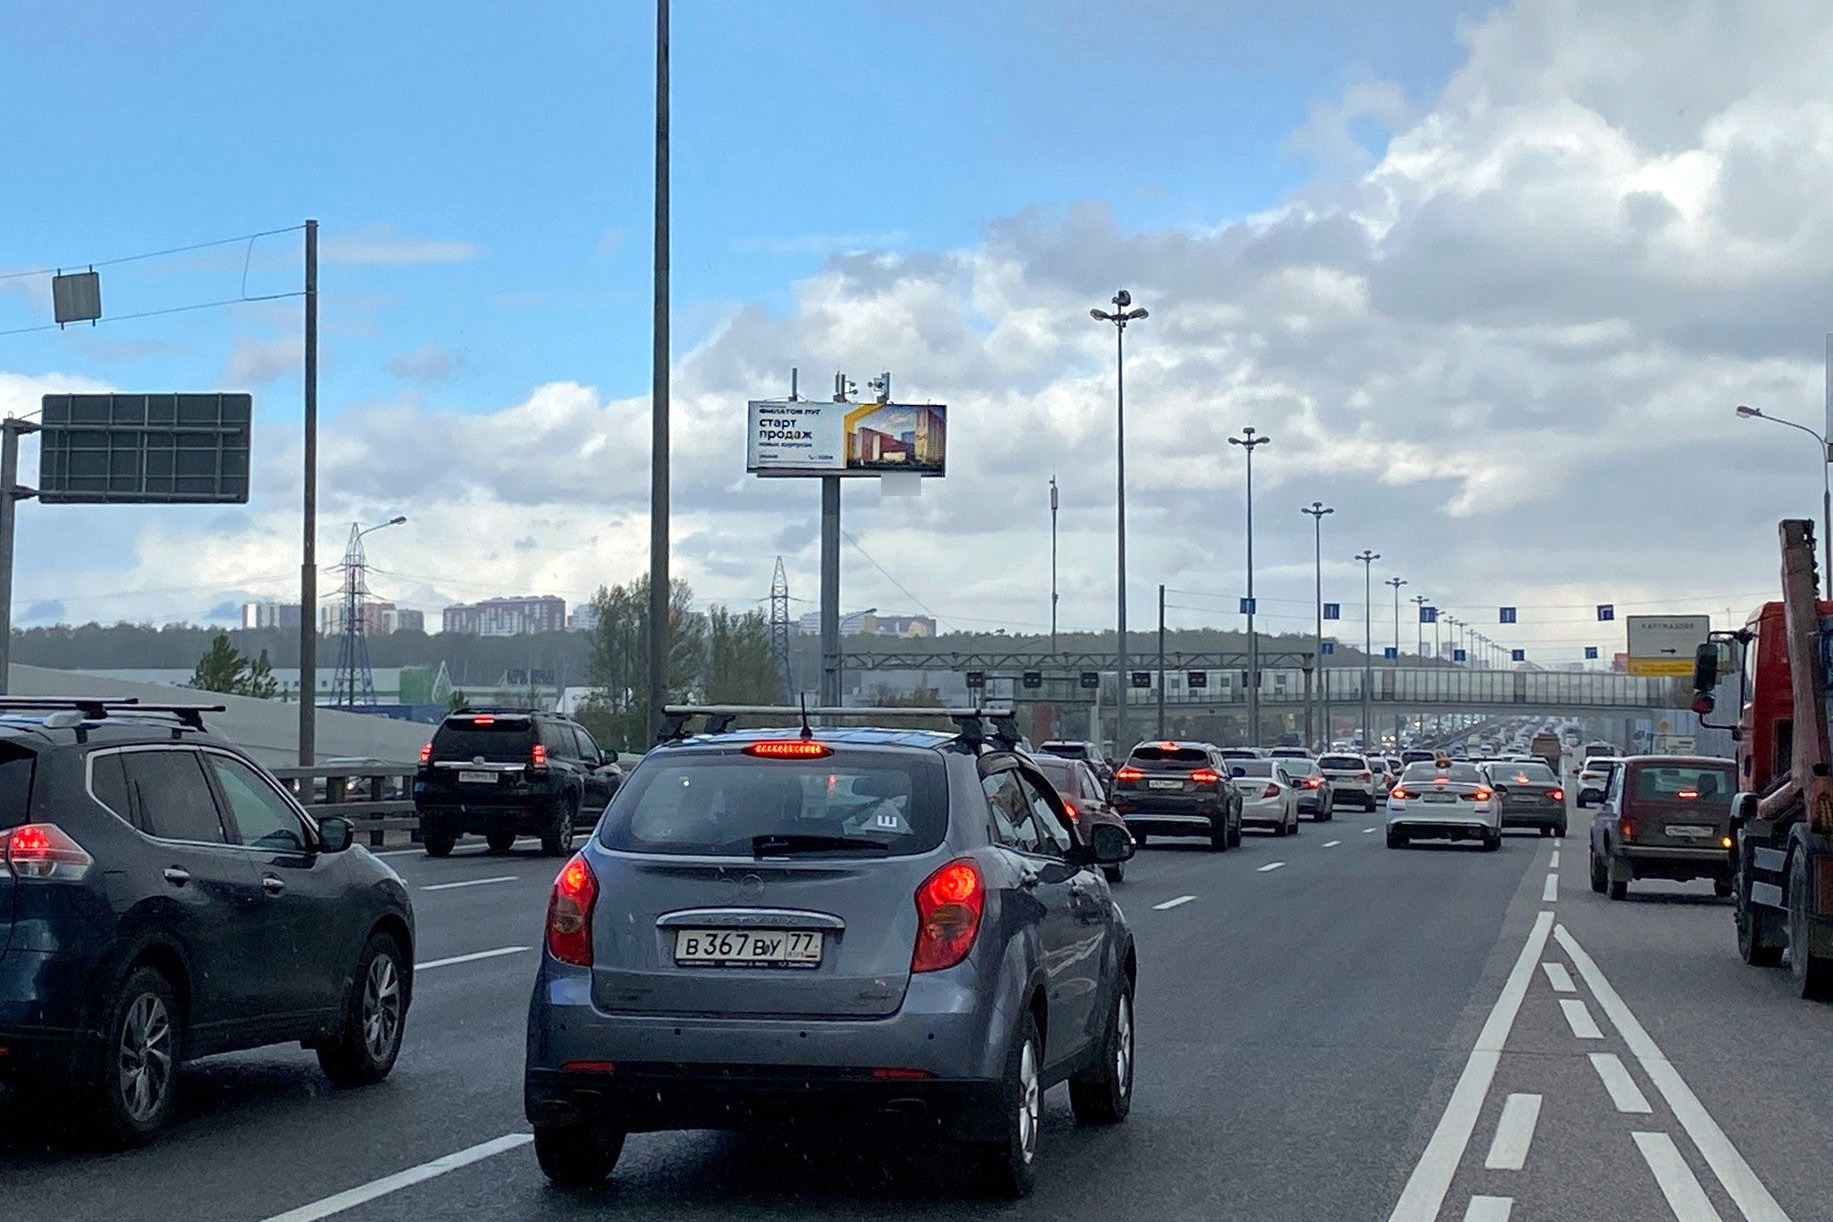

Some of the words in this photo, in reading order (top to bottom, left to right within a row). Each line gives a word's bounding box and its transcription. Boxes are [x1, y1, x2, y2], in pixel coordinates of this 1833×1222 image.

[759, 418, 797, 430] старт
[759, 430, 813, 441] продаж
[790, 933, 814, 951] 77
